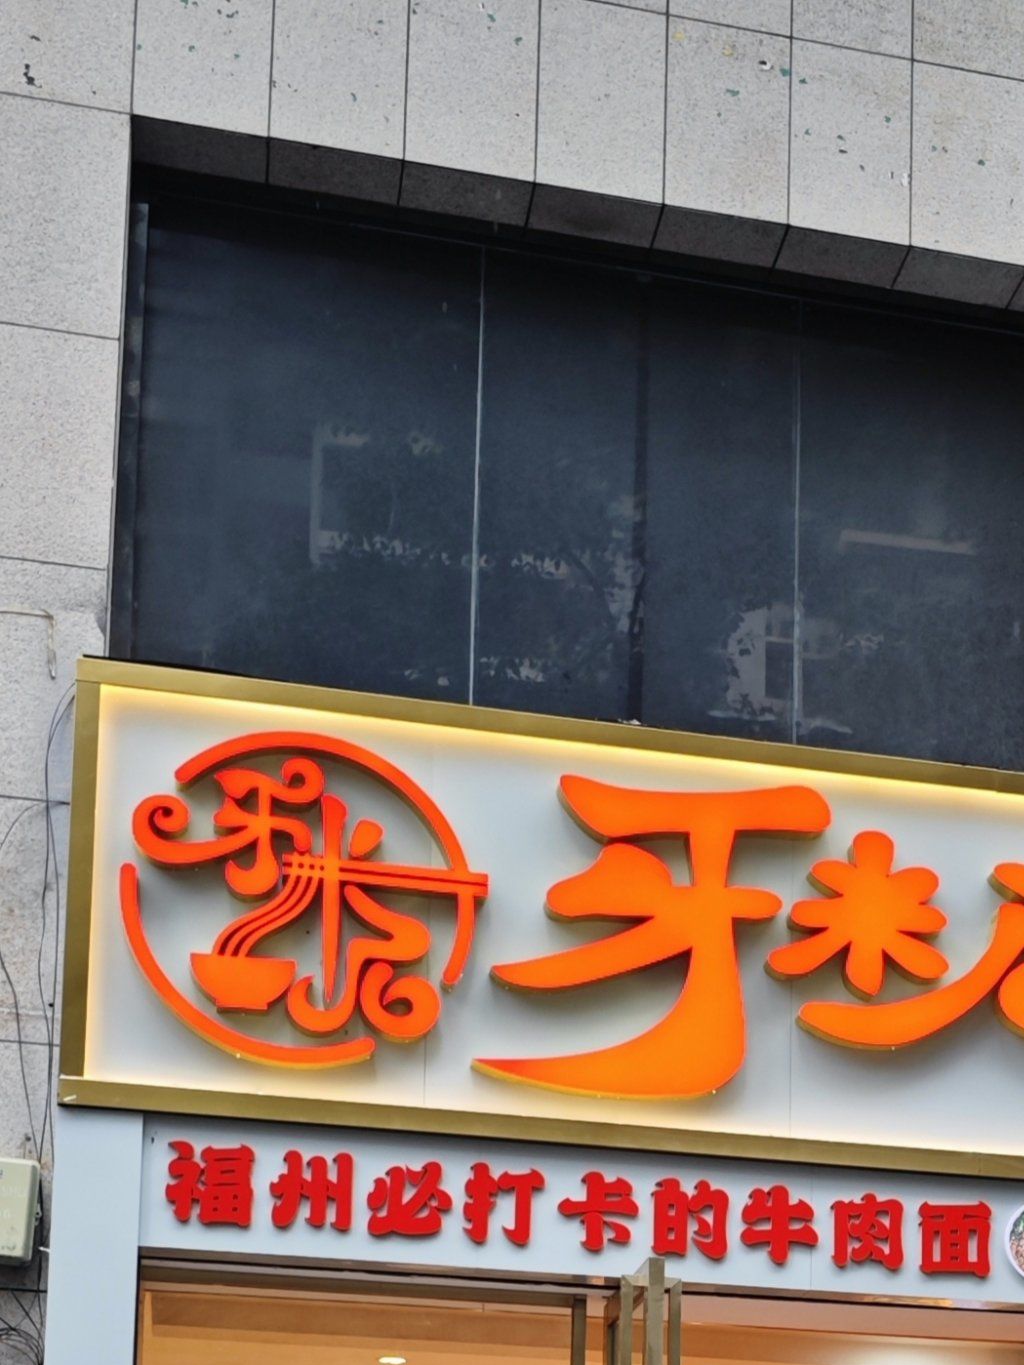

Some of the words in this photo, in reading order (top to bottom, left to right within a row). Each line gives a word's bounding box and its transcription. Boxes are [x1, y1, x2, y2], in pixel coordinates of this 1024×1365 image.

[165, 1140, 994, 1279] 福州必打卡的牛肉面
